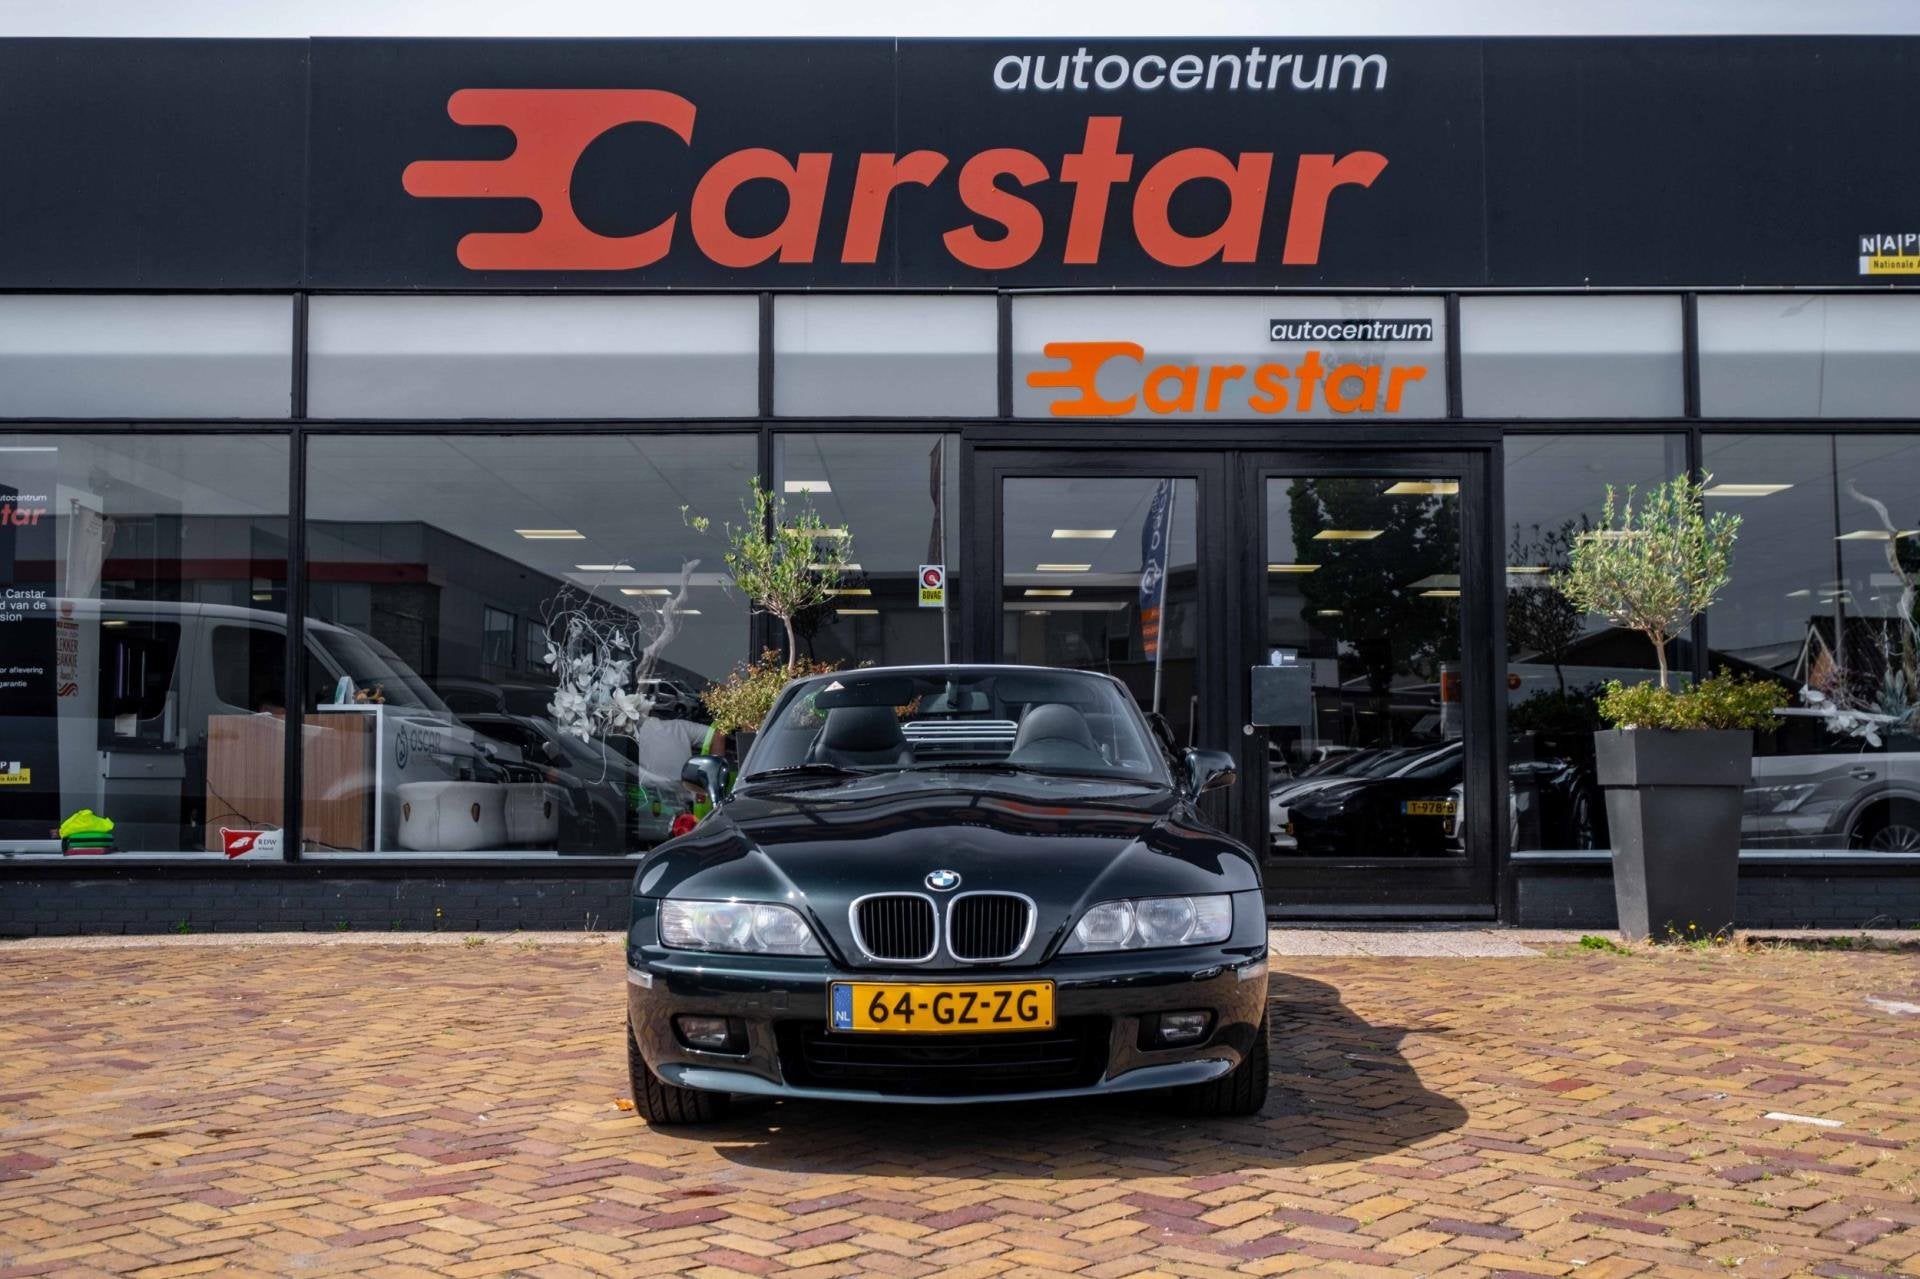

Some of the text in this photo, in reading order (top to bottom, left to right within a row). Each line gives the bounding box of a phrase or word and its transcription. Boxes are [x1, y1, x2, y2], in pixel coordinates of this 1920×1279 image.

[993, 47, 1388, 91] autocentrum
[402, 88, 1389, 271] Carstar
[1873, 260, 1914, 269] Nationale
[1271, 320, 1432, 340] autocentrum
[1026, 341, 1428, 416] Carstar
[6, 588, 46, 599] Carstar
[922, 590, 942, 600] BOVAG
[10, 602, 30, 610] van
[33, 600, 47, 610] de
[57, 637, 79, 653] LEKKER
[9, 666, 43, 675] aflevering
[410, 729, 441, 754] OSCAR
[1411, 801, 1457, 814] T-978-B
[836, 989, 1039, 1025] NL 64-GZ-ZG
